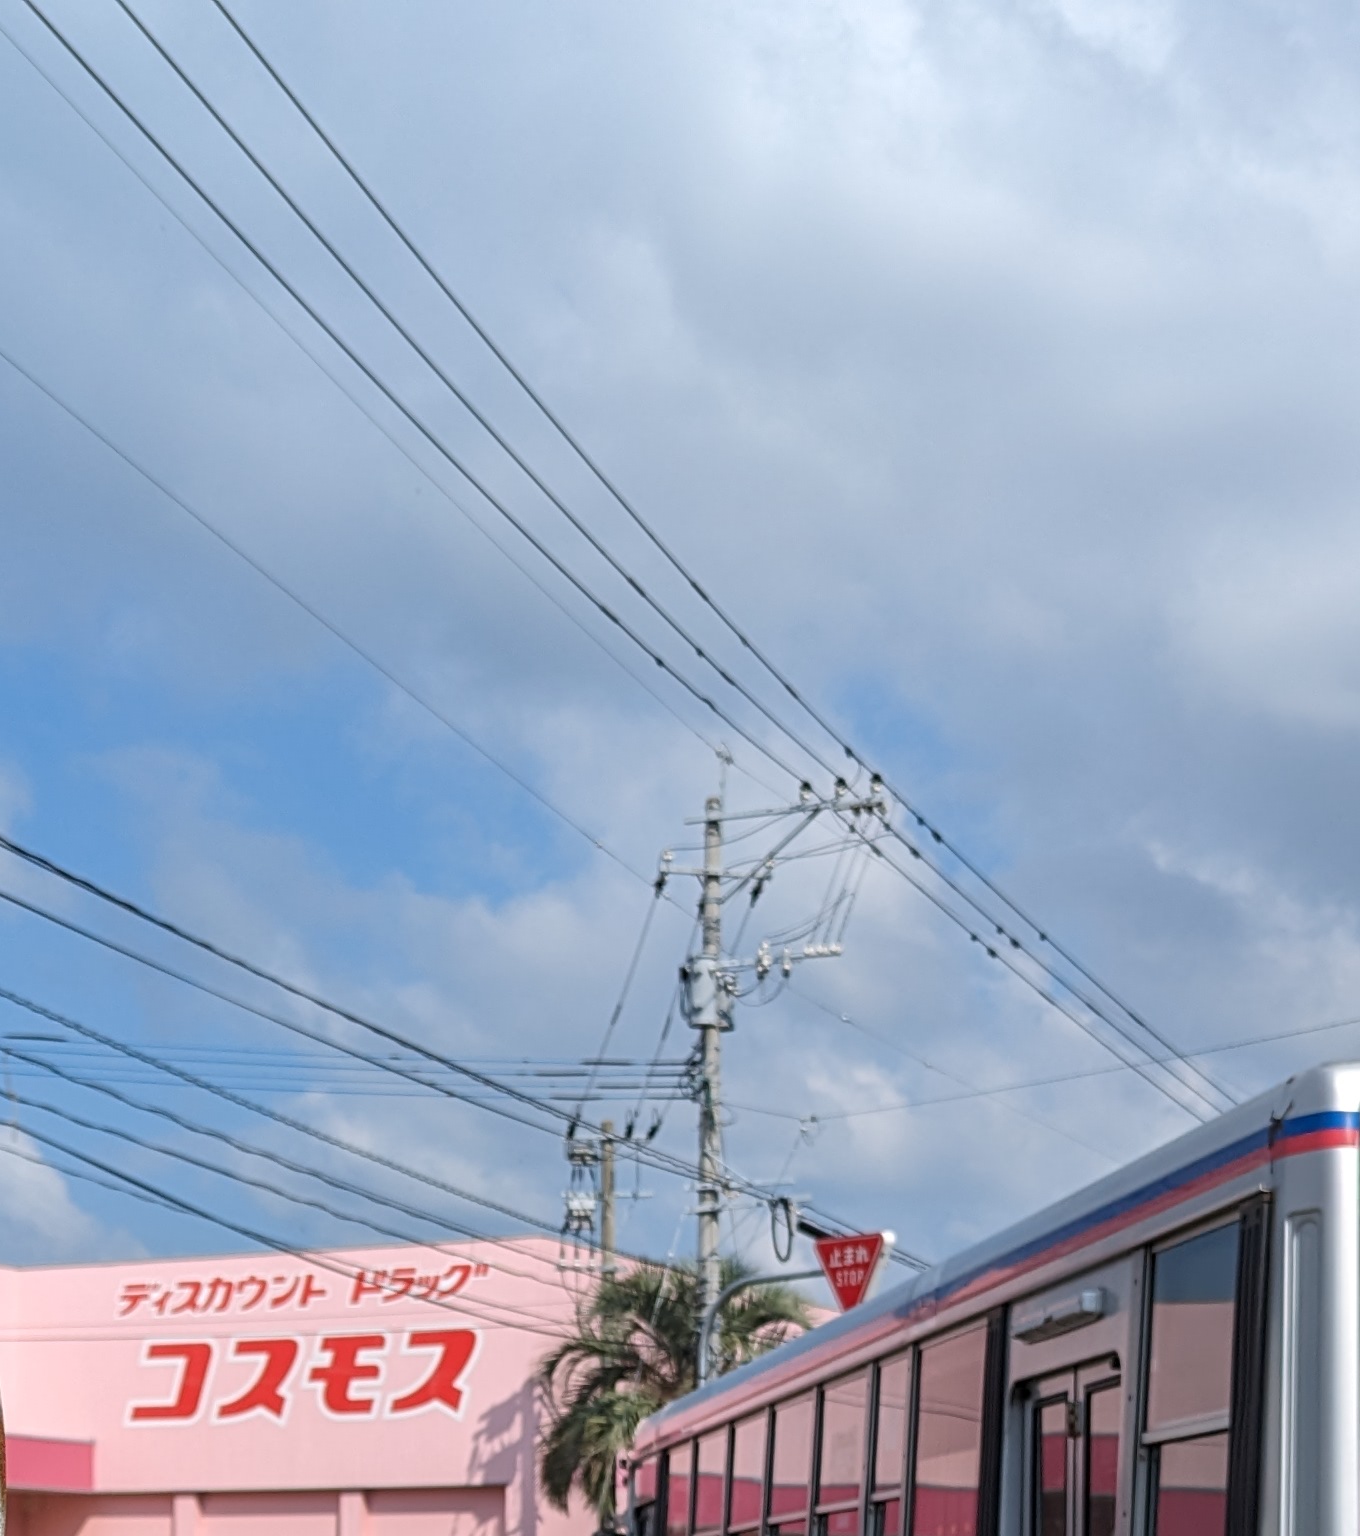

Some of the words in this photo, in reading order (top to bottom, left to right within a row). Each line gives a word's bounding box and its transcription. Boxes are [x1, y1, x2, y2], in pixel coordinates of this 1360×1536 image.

[828, 1244, 870, 1269] 止まれ
[118, 1273, 326, 1318] ディスカウント
[350, 1263, 490, 1306] ドラッグ
[835, 1269, 865, 1288] STOP
[130, 1328, 477, 1421] コスモス
